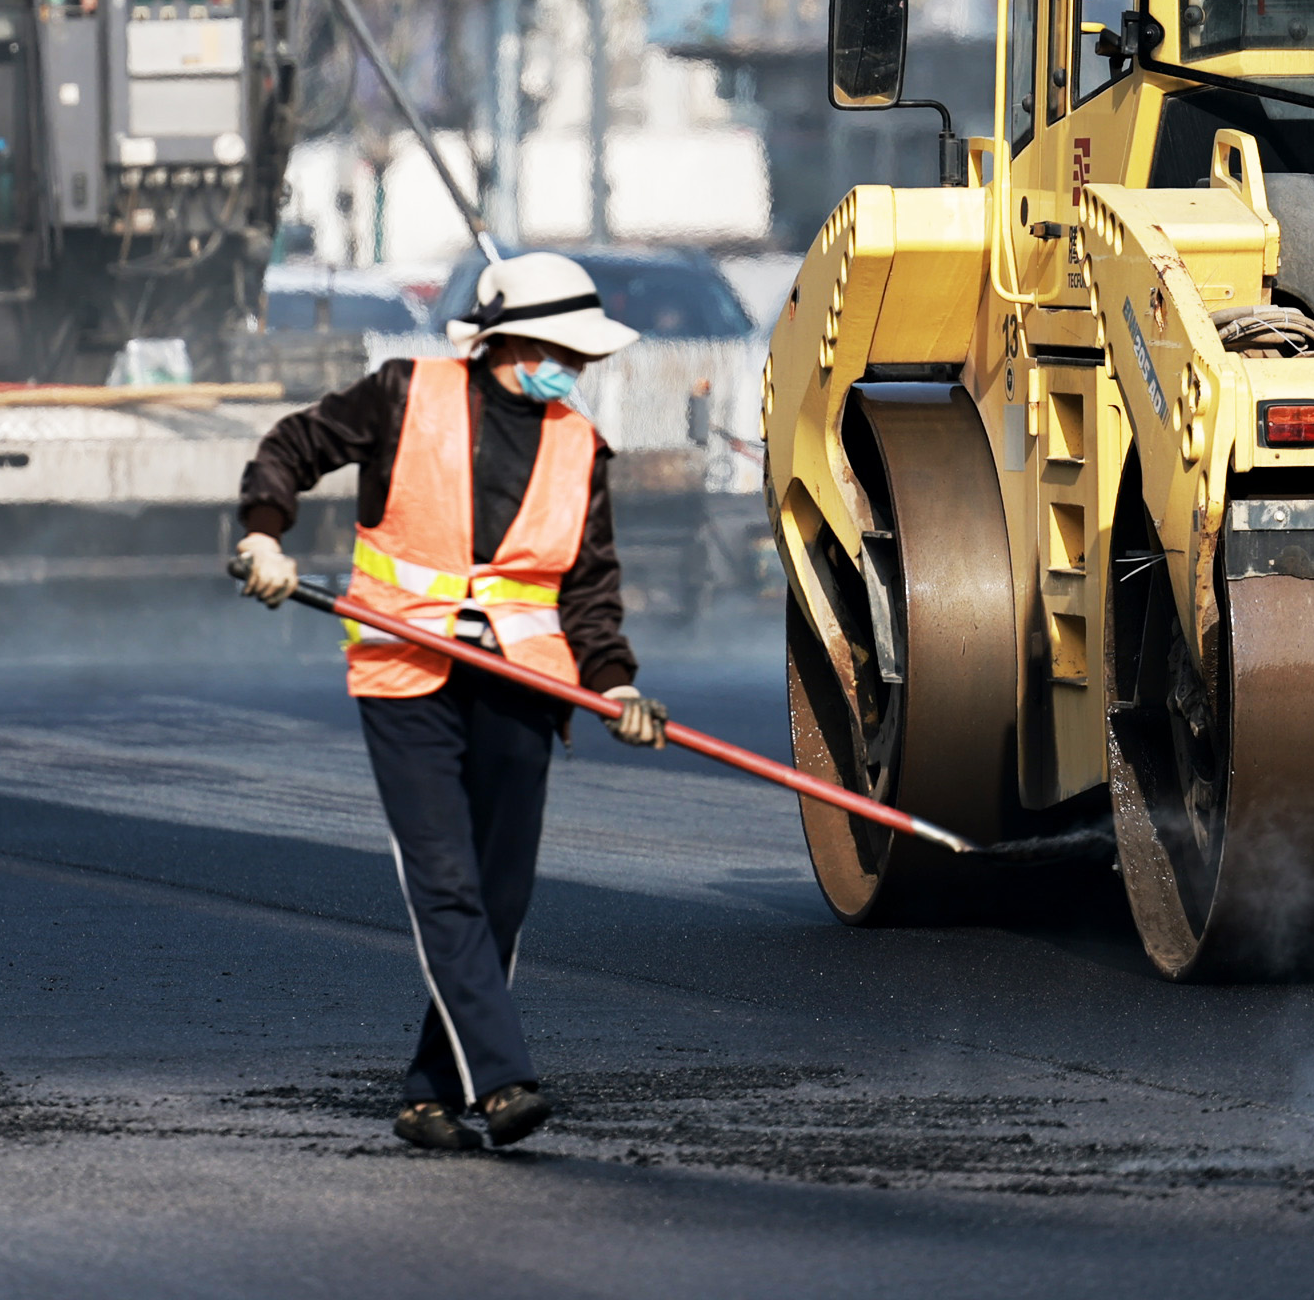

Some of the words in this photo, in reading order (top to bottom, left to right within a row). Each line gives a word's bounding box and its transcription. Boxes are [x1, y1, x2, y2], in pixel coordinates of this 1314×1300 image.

[1002, 314, 1019, 358] 13
[1133, 334, 1151, 381] 205
[1147, 380, 1162, 414] AD
